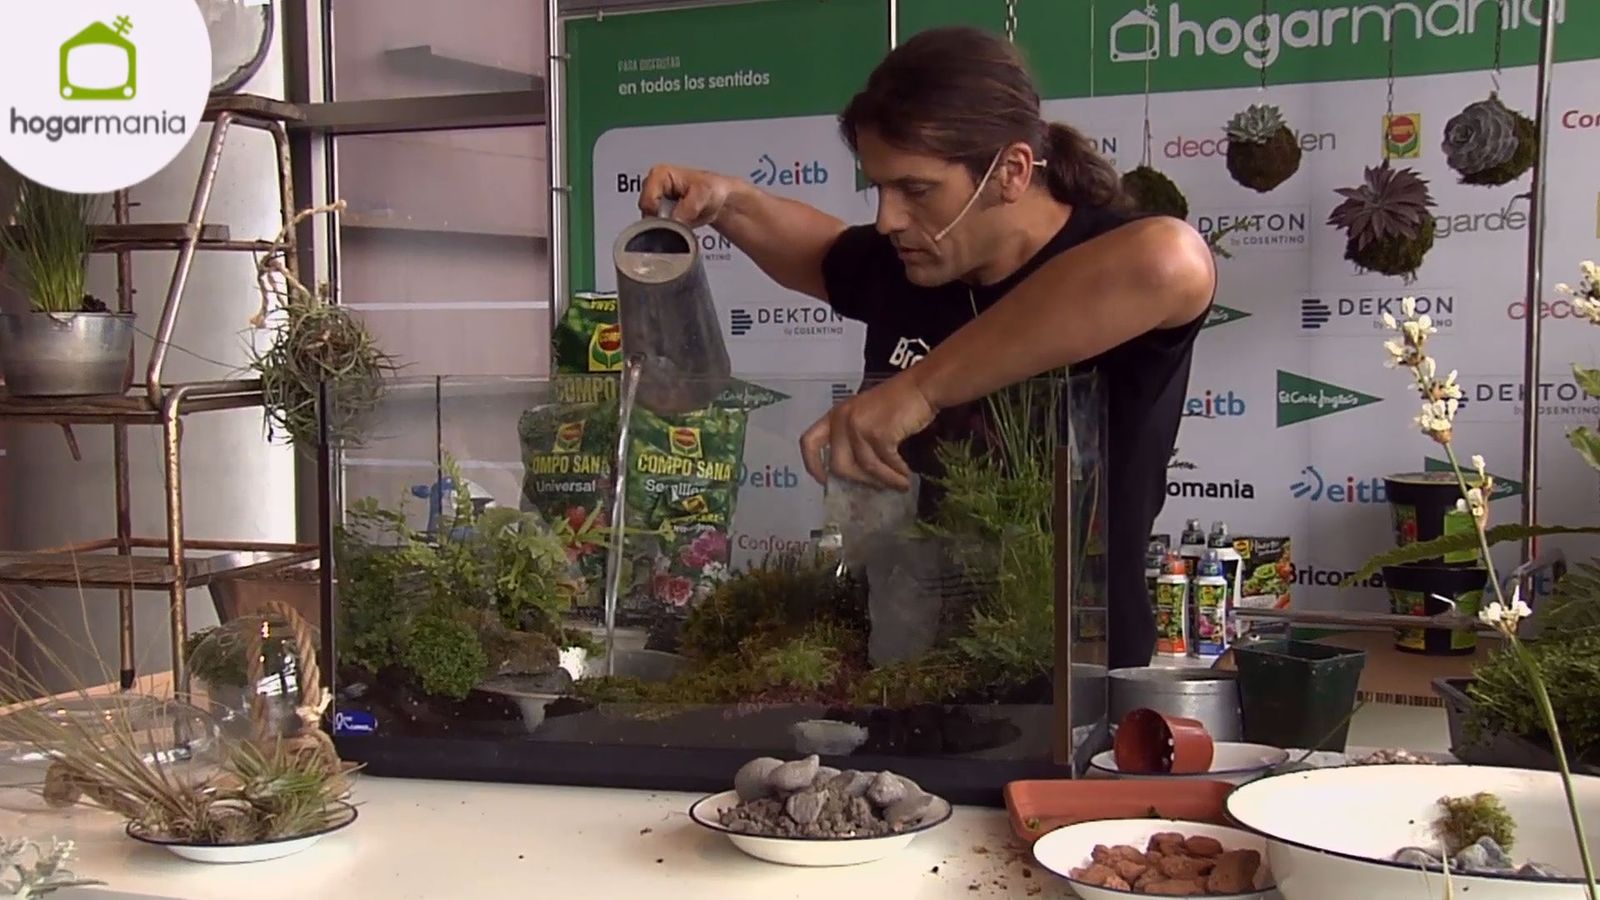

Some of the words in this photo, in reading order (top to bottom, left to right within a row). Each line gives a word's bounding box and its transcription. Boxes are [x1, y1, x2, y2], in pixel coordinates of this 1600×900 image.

[618, 83, 637, 96] en
[640, 77, 682, 94] todos
[684, 75, 705, 91] los
[708, 70, 771, 89] sentidos
[779, 161, 828, 185] eitb
[1198, 213, 1305, 234] DEKTON
[1243, 235, 1305, 245] COSENTINO
[757, 307, 845, 324] DEKTON
[794, 326, 844, 336] COSENTINO
[1186, 390, 1246, 416] eitb
[637, 452, 692, 477] COMPO
[696, 460, 732, 482] SANA
[750, 465, 799, 489] eitb
[535, 480, 596, 493] Universal
